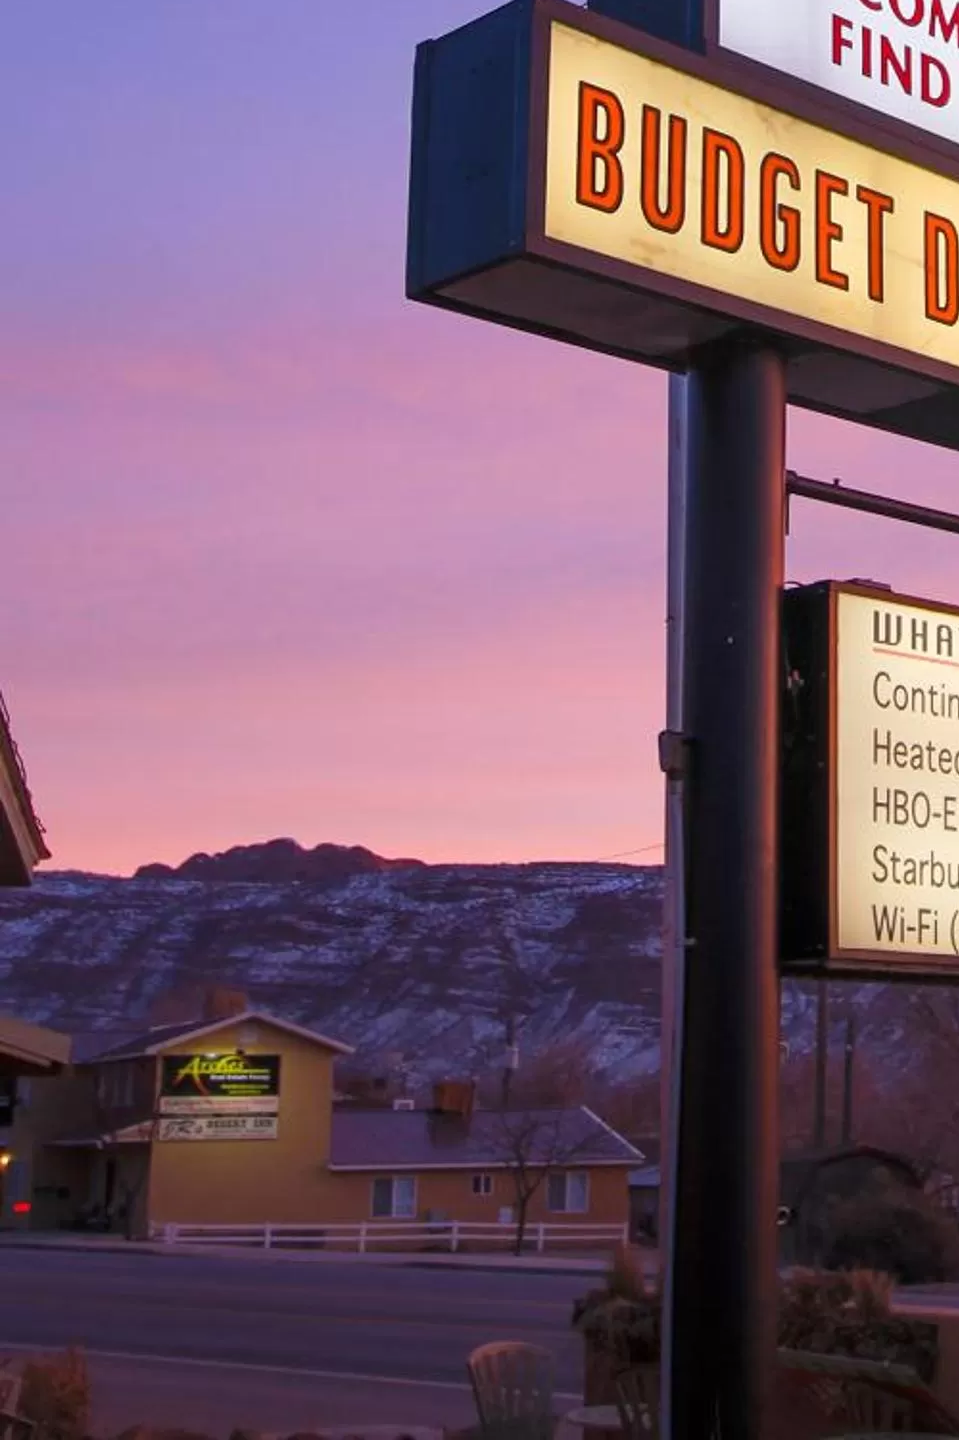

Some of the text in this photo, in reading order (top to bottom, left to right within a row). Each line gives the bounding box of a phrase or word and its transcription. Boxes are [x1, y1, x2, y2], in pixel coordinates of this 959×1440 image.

[831, 13, 951, 109] FIND
[576, 81, 893, 303] BUDGET
[871, 904, 939, 946] Wi-Fi
